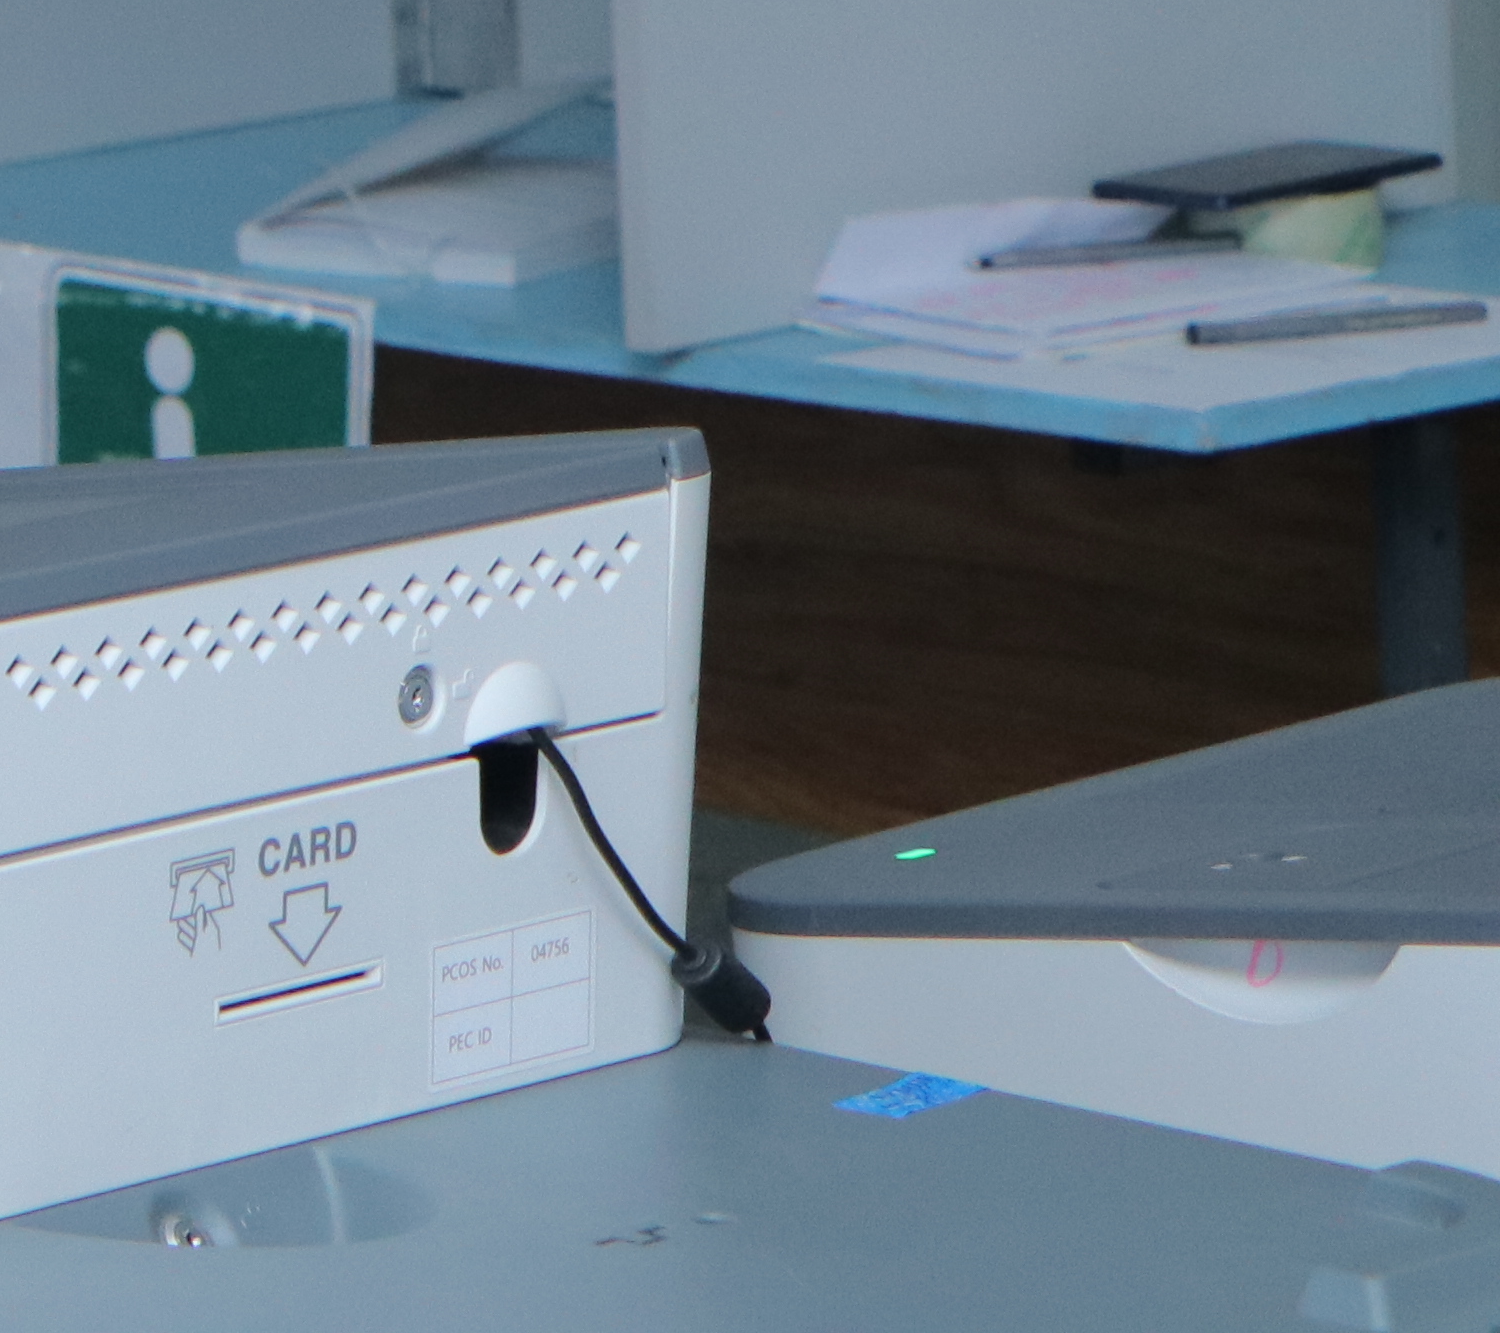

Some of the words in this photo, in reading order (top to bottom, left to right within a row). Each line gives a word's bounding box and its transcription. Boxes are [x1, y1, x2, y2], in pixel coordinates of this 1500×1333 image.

[258, 820, 357, 877] CARD
[530, 937, 570, 963] 04756
[441, 958, 477, 983] PCOS
[482, 955, 504, 973] No.
[449, 1030, 473, 1053] PEC
[478, 1027, 492, 1045] ID
